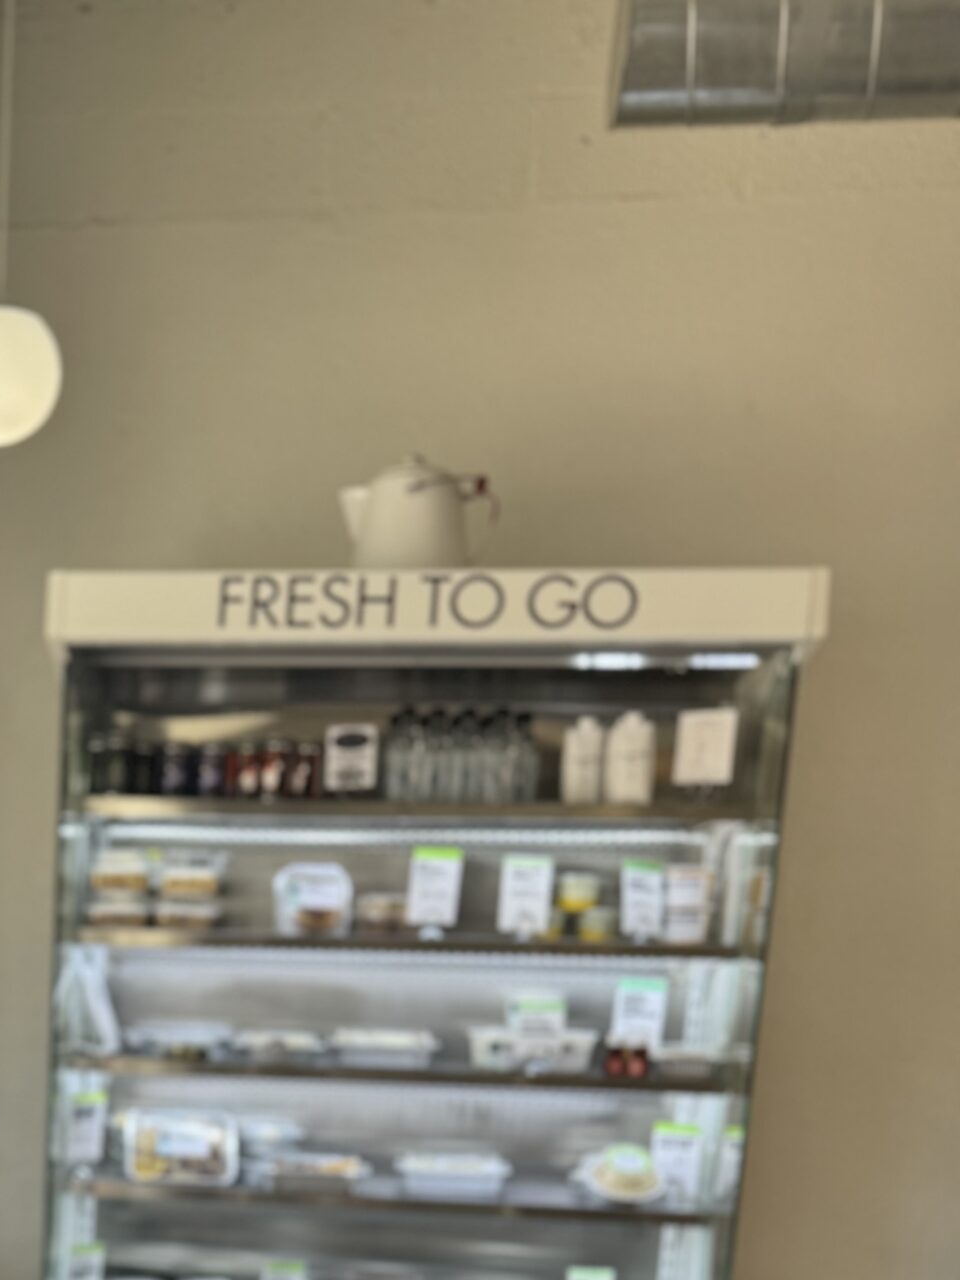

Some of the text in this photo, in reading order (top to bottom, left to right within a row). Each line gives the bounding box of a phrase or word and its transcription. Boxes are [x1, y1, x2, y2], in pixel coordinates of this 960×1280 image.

[217, 573, 639, 630] FRESH TO GO
